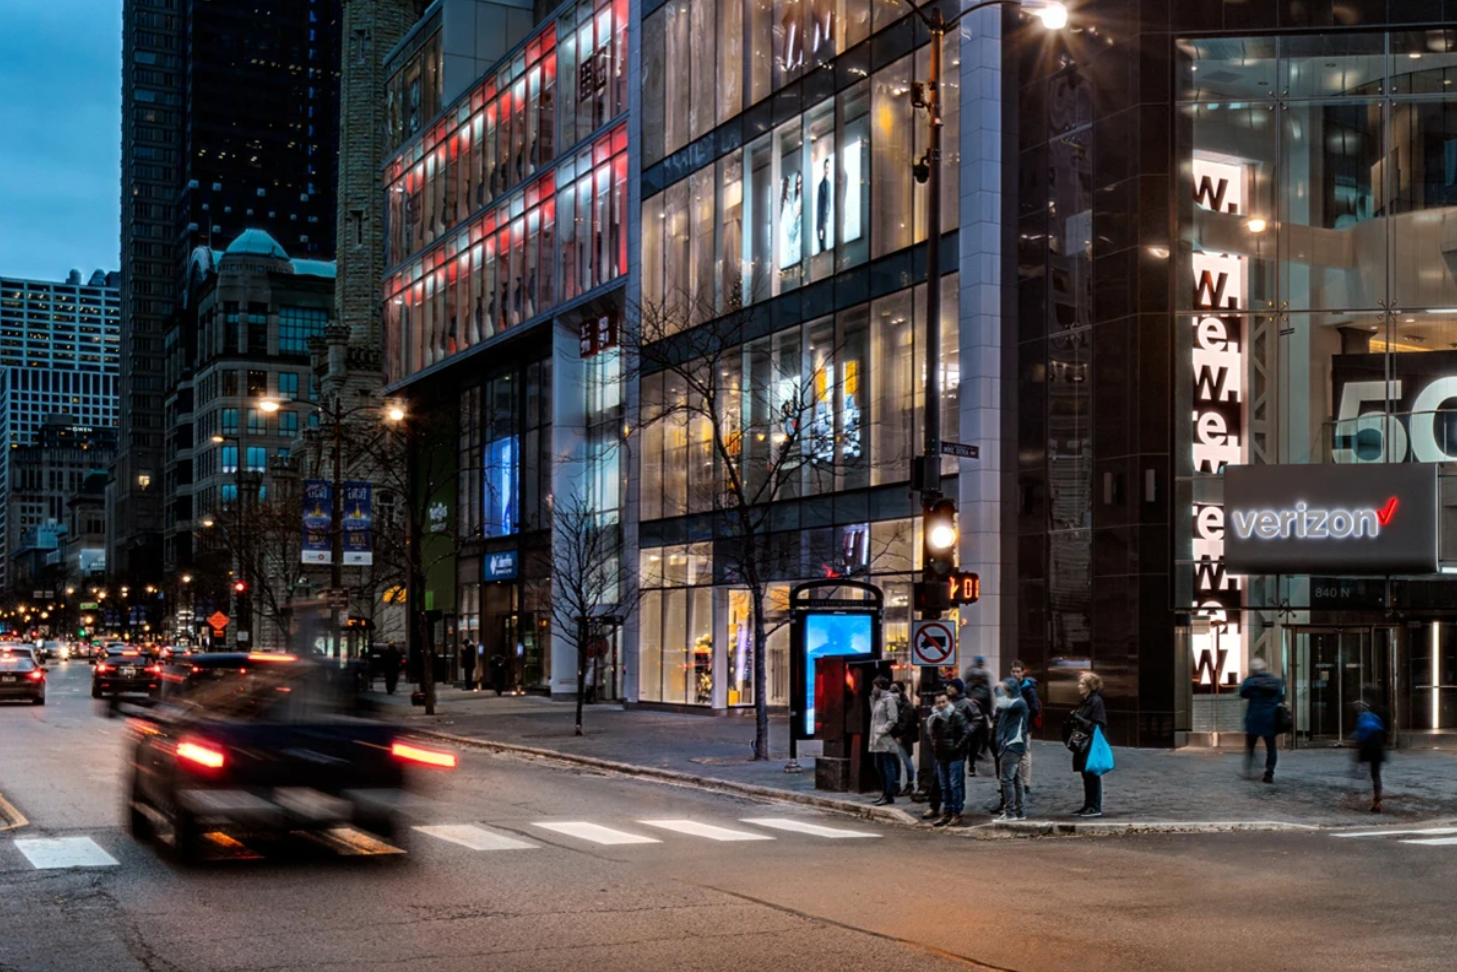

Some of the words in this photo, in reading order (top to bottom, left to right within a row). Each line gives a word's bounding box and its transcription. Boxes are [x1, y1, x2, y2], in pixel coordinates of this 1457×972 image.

[1232, 501, 1379, 539] verizon
[1314, 587, 1338, 599] 840
[1340, 587, 1351, 598] N
